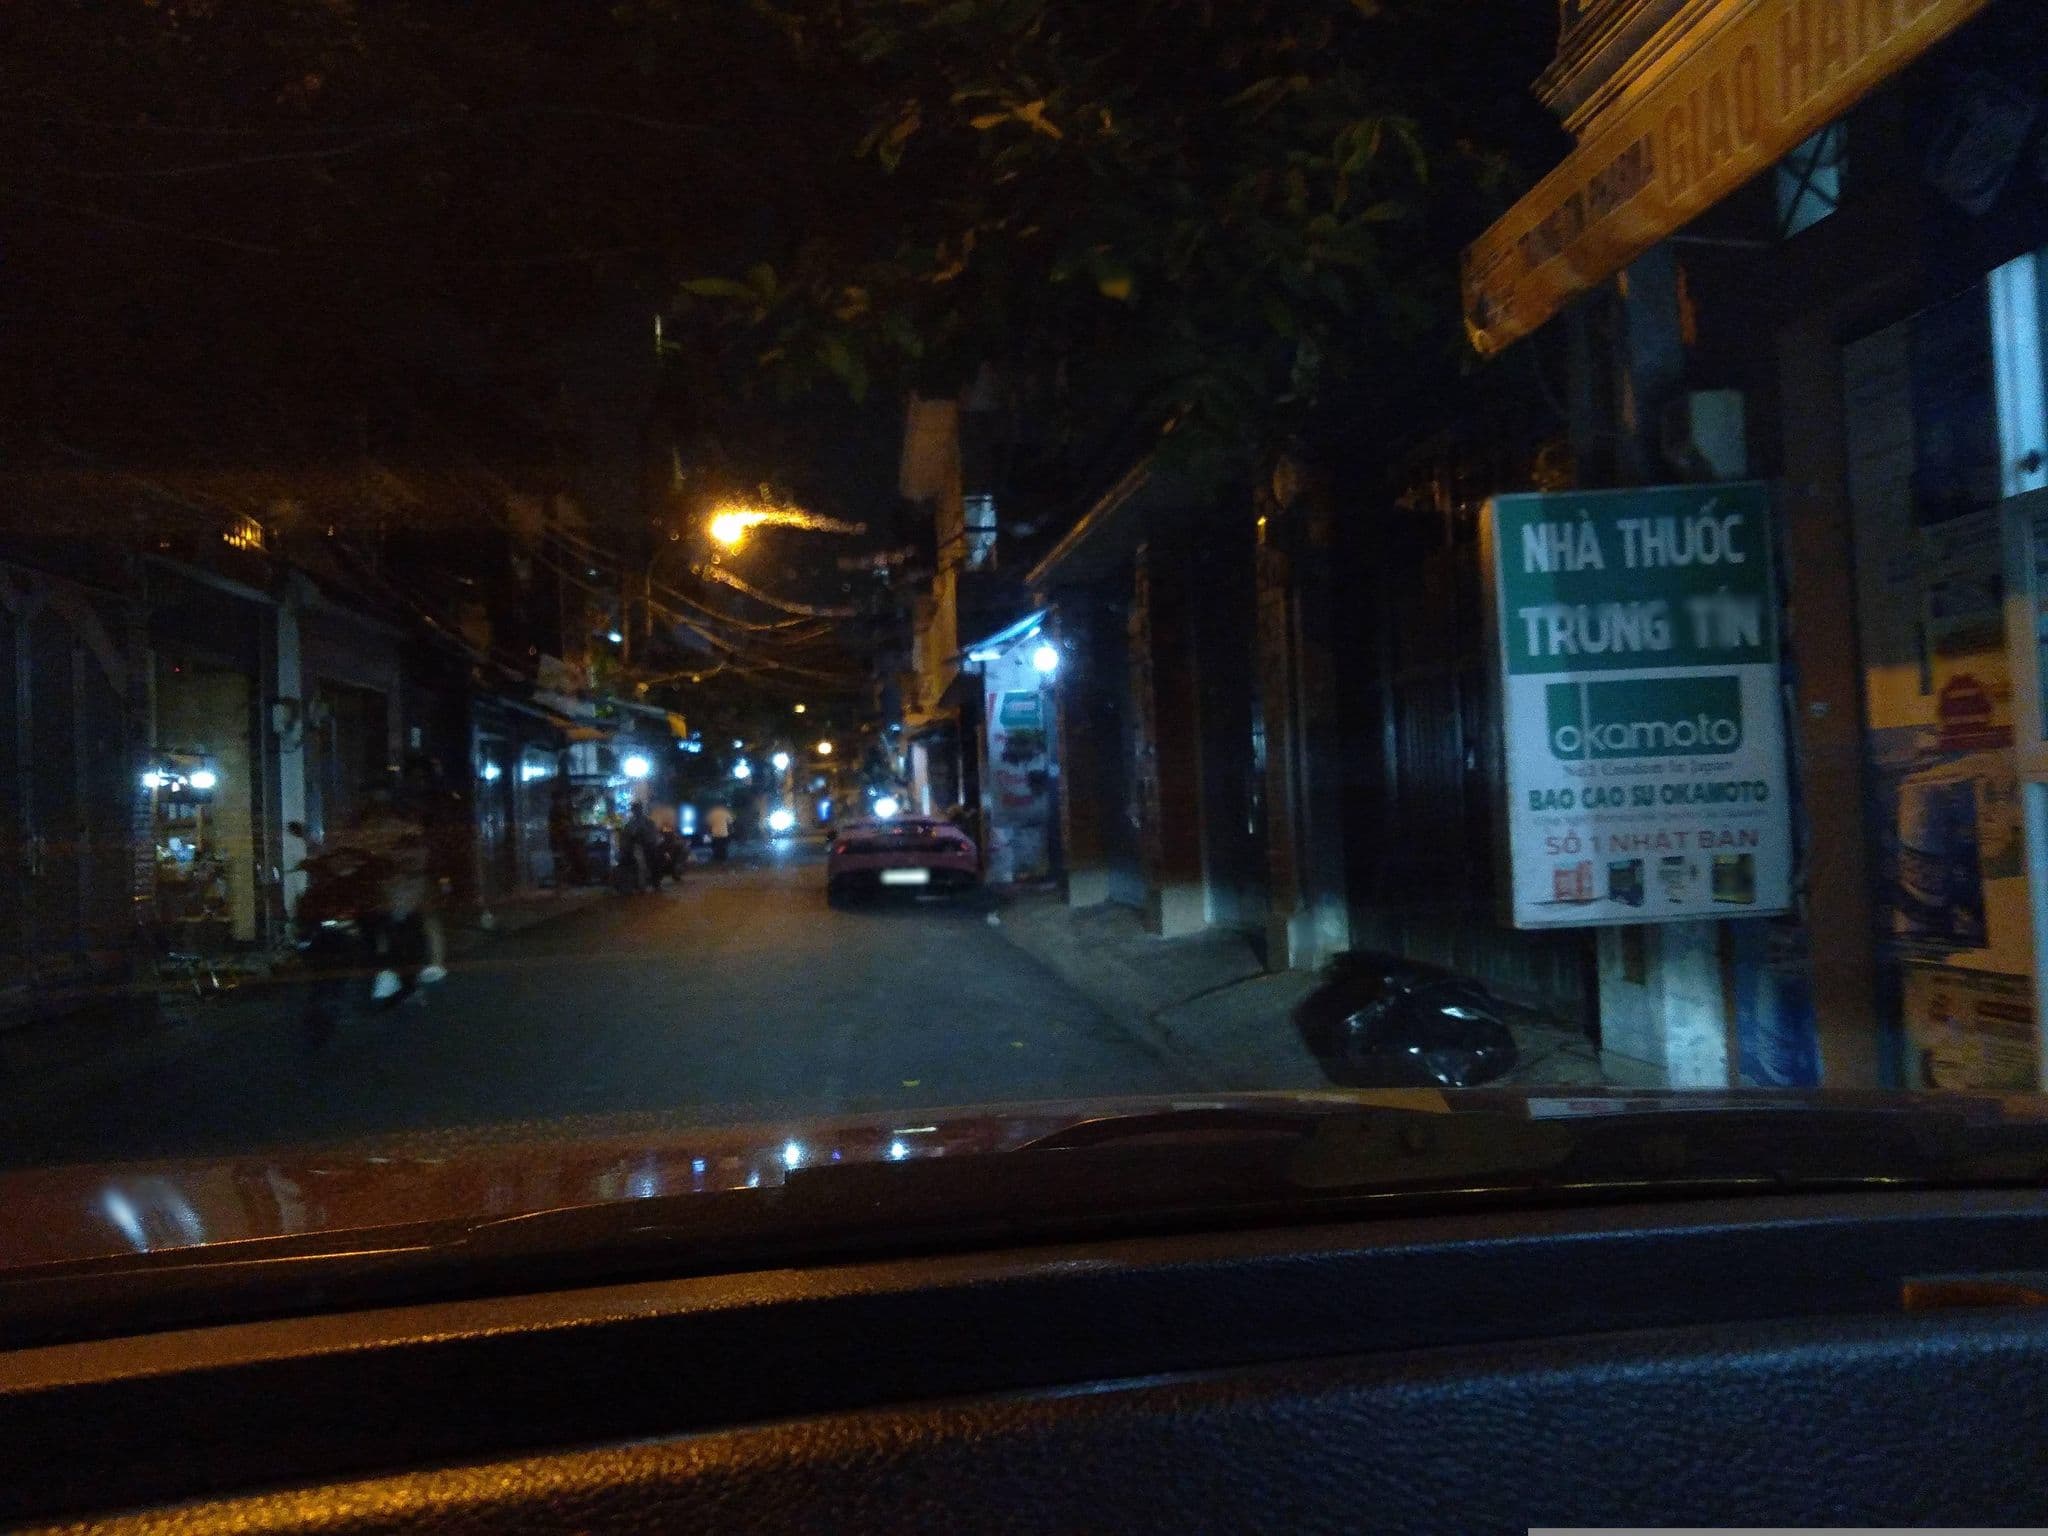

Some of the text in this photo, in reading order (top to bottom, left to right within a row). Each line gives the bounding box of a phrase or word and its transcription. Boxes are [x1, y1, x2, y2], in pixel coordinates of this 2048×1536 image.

[1662, 44, 1762, 204] GIAO
[1521, 498, 1746, 574] NHÀ THUỐC
[1518, 601, 1671, 657] TRUNG
[1553, 690, 1741, 758] okamoto
[1528, 780, 1770, 811] BAO CAO SU OKAMOTO
[1591, 835, 1602, 852] 1
